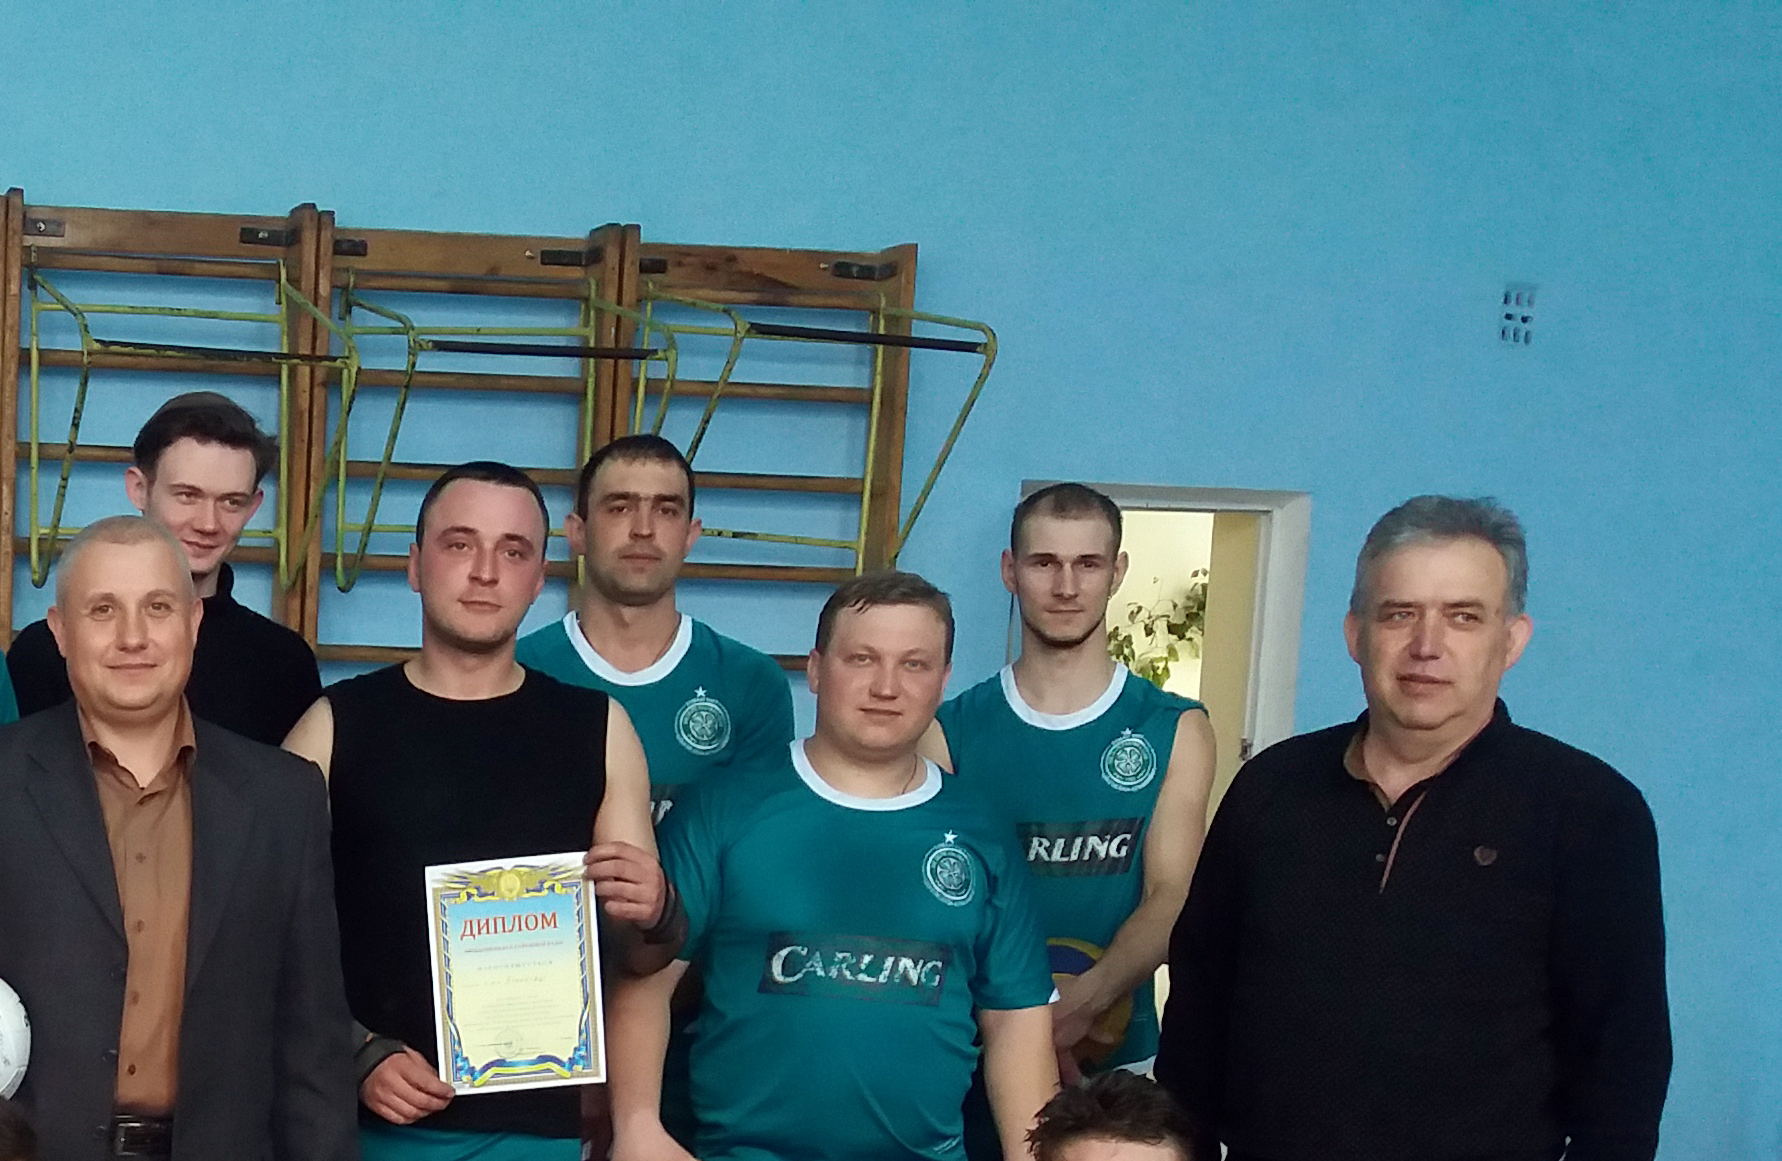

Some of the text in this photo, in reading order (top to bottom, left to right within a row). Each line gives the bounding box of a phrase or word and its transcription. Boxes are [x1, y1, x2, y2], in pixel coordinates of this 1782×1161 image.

[1027, 833, 1132, 862] RLING
[460, 912, 558, 941] ДИПЛОМ
[771, 945, 943, 987] CARLING
